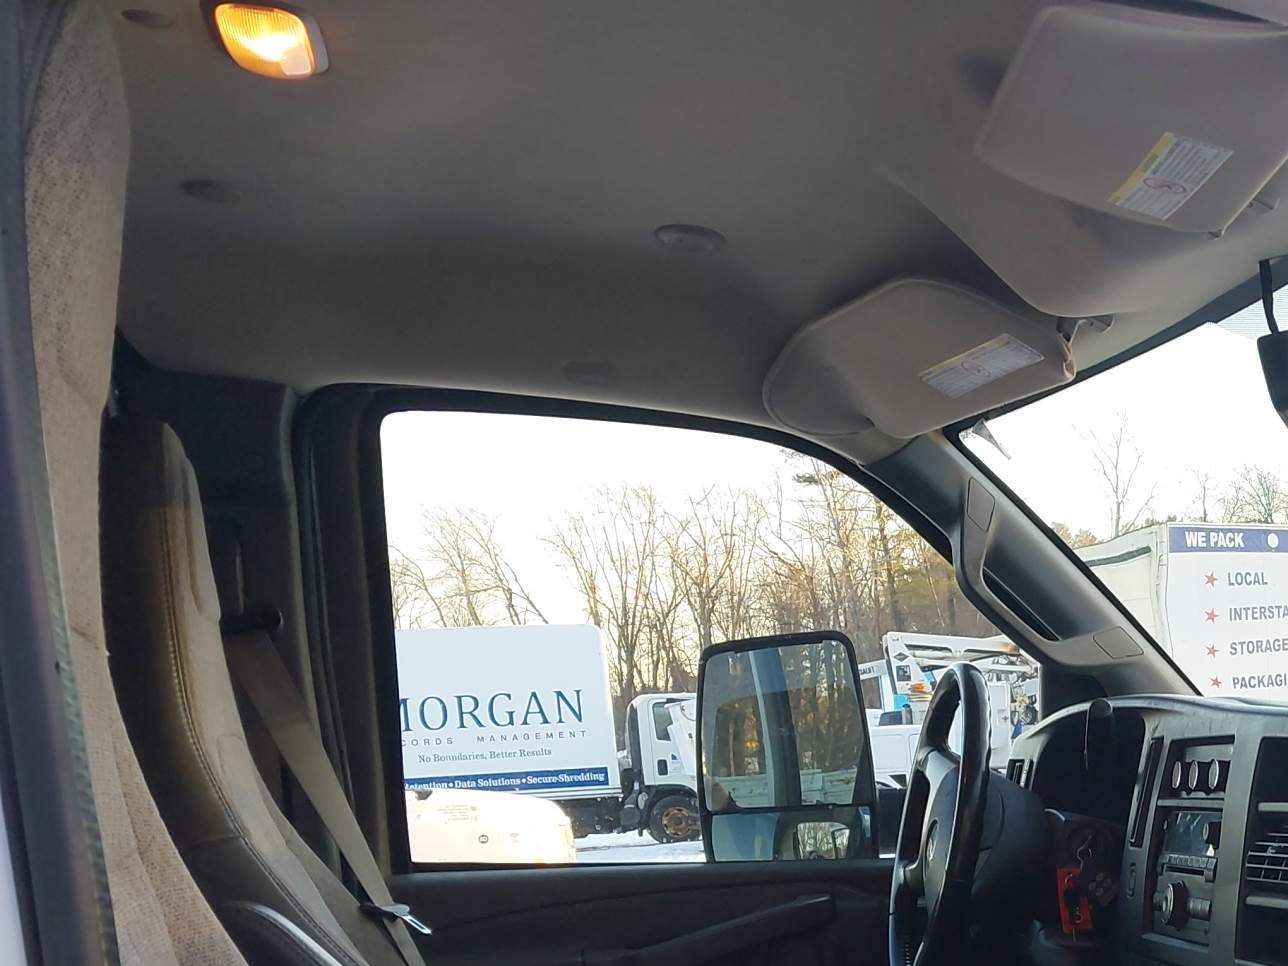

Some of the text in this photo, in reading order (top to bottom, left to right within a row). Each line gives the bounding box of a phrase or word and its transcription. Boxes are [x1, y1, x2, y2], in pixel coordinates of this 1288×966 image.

[1185, 531, 1206, 548] WE
[1210, 531, 1245, 548] PACK
[1228, 572, 1268, 587] LOCAL
[1230, 638, 1288, 656] STORAGE
[477, 730, 586, 743] MANAGEMENT
[418, 753, 431, 763] No
[489, 750, 516, 760] Better
[519, 748, 552, 758] Results
[454, 779, 476, 788] Data
[477, 776, 520, 788] Solutions
